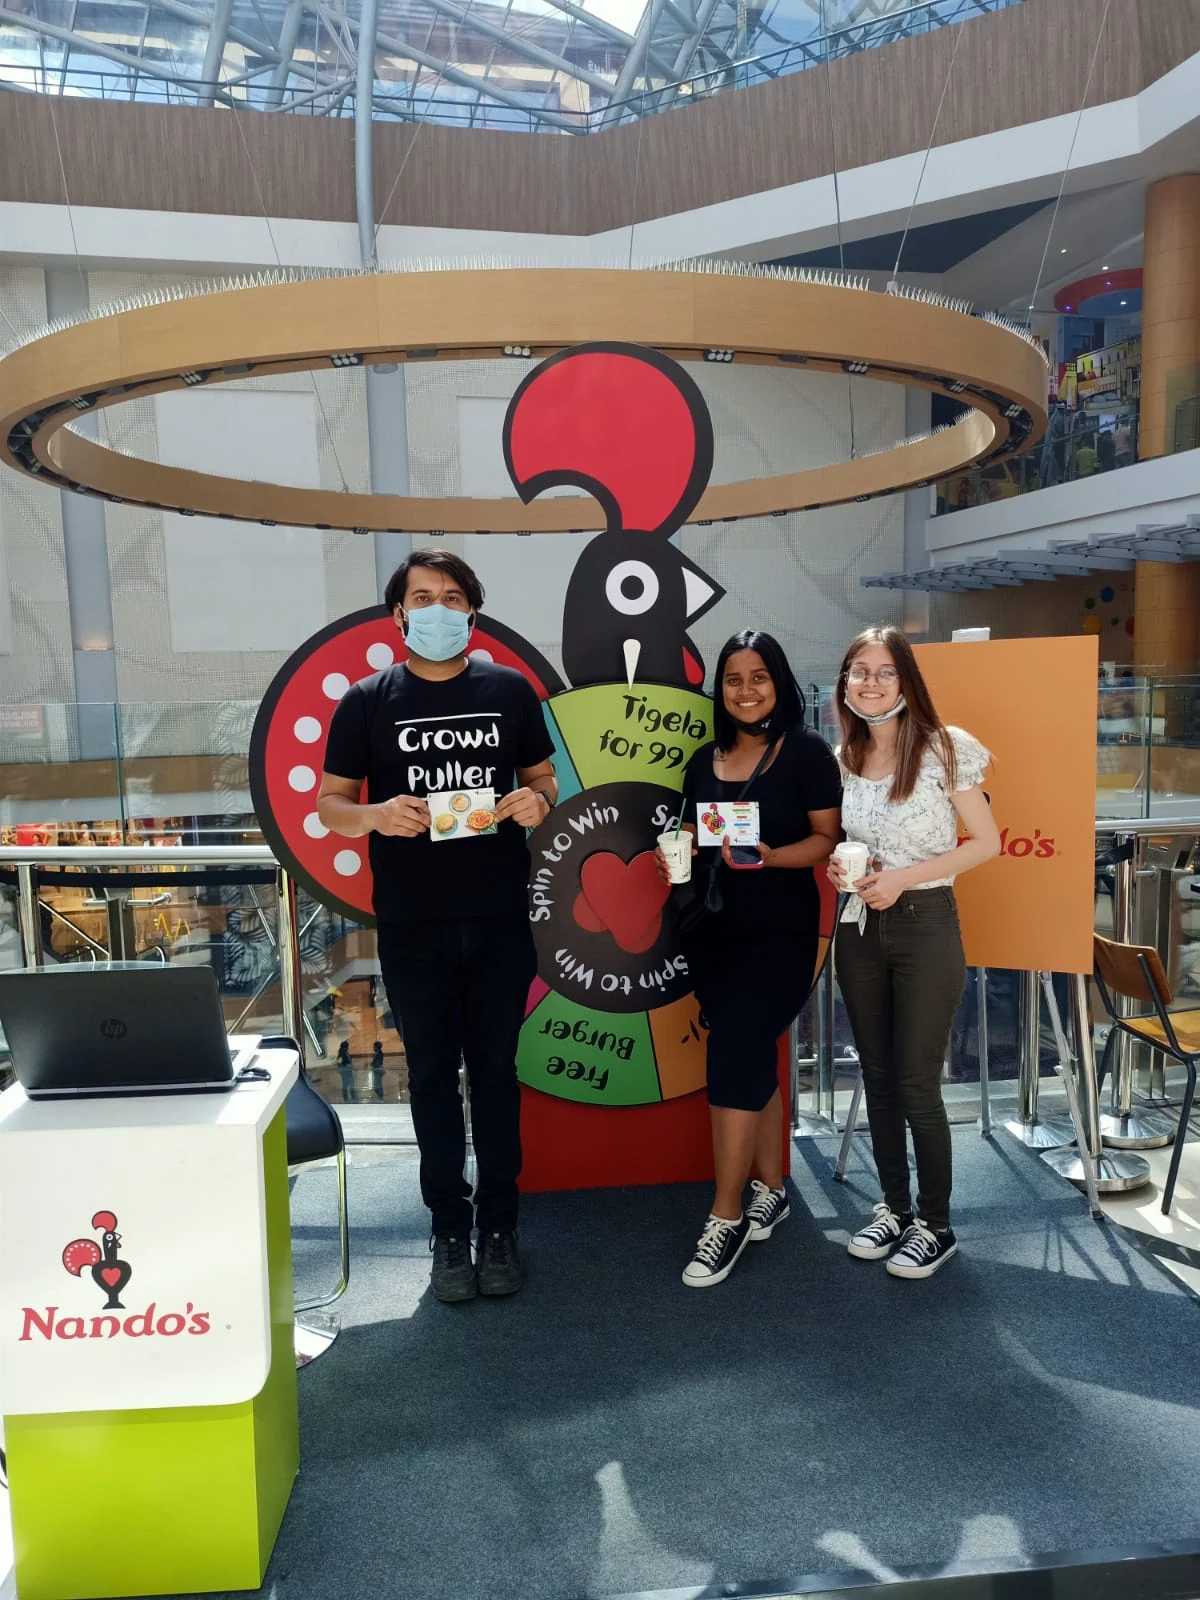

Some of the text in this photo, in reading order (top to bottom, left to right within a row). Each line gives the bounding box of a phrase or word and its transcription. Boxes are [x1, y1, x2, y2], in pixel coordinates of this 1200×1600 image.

[398, 722, 500, 752] Crowd
[622, 695, 707, 741] Tigela
[599, 729, 643, 760] for
[526, 801, 620, 923] Spin to Win
[554, 948, 690, 997] Spin to Win
[537, 1017, 637, 1061] Burger
[546, 1055, 610, 1091] Free
[17, 1302, 211, 1342] Nando's
